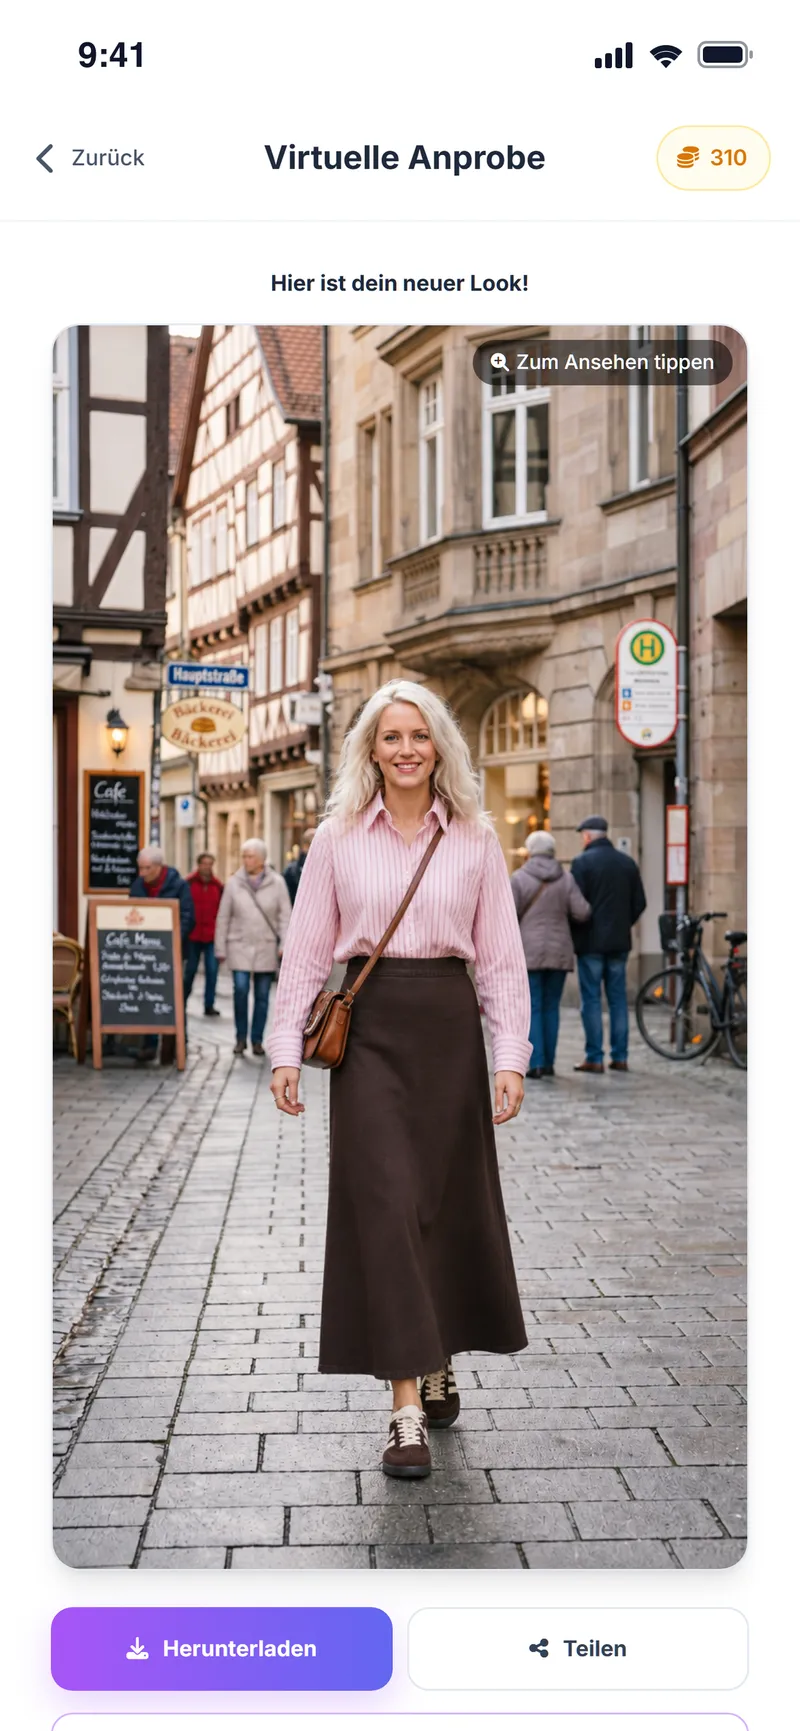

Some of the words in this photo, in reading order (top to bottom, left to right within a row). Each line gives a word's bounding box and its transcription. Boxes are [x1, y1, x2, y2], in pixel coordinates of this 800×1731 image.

[79, 42, 142, 68] 9:41
[72, 148, 145, 167] Zurück
[264, 144, 399, 170] Virtuelle
[408, 145, 545, 176] Anprobe
[710, 149, 747, 166] 310
[271, 274, 315, 291] Hier
[321, 274, 346, 291] ist
[352, 274, 397, 291] dein
[403, 278, 465, 291] neuer
[471, 274, 529, 291] Look!
[639, 638, 656, 658] H
[173, 666, 245, 685] Hauptstraße
[163, 1639, 317, 1658] Herunterladen
[563, 1639, 627, 1657] Teilen
